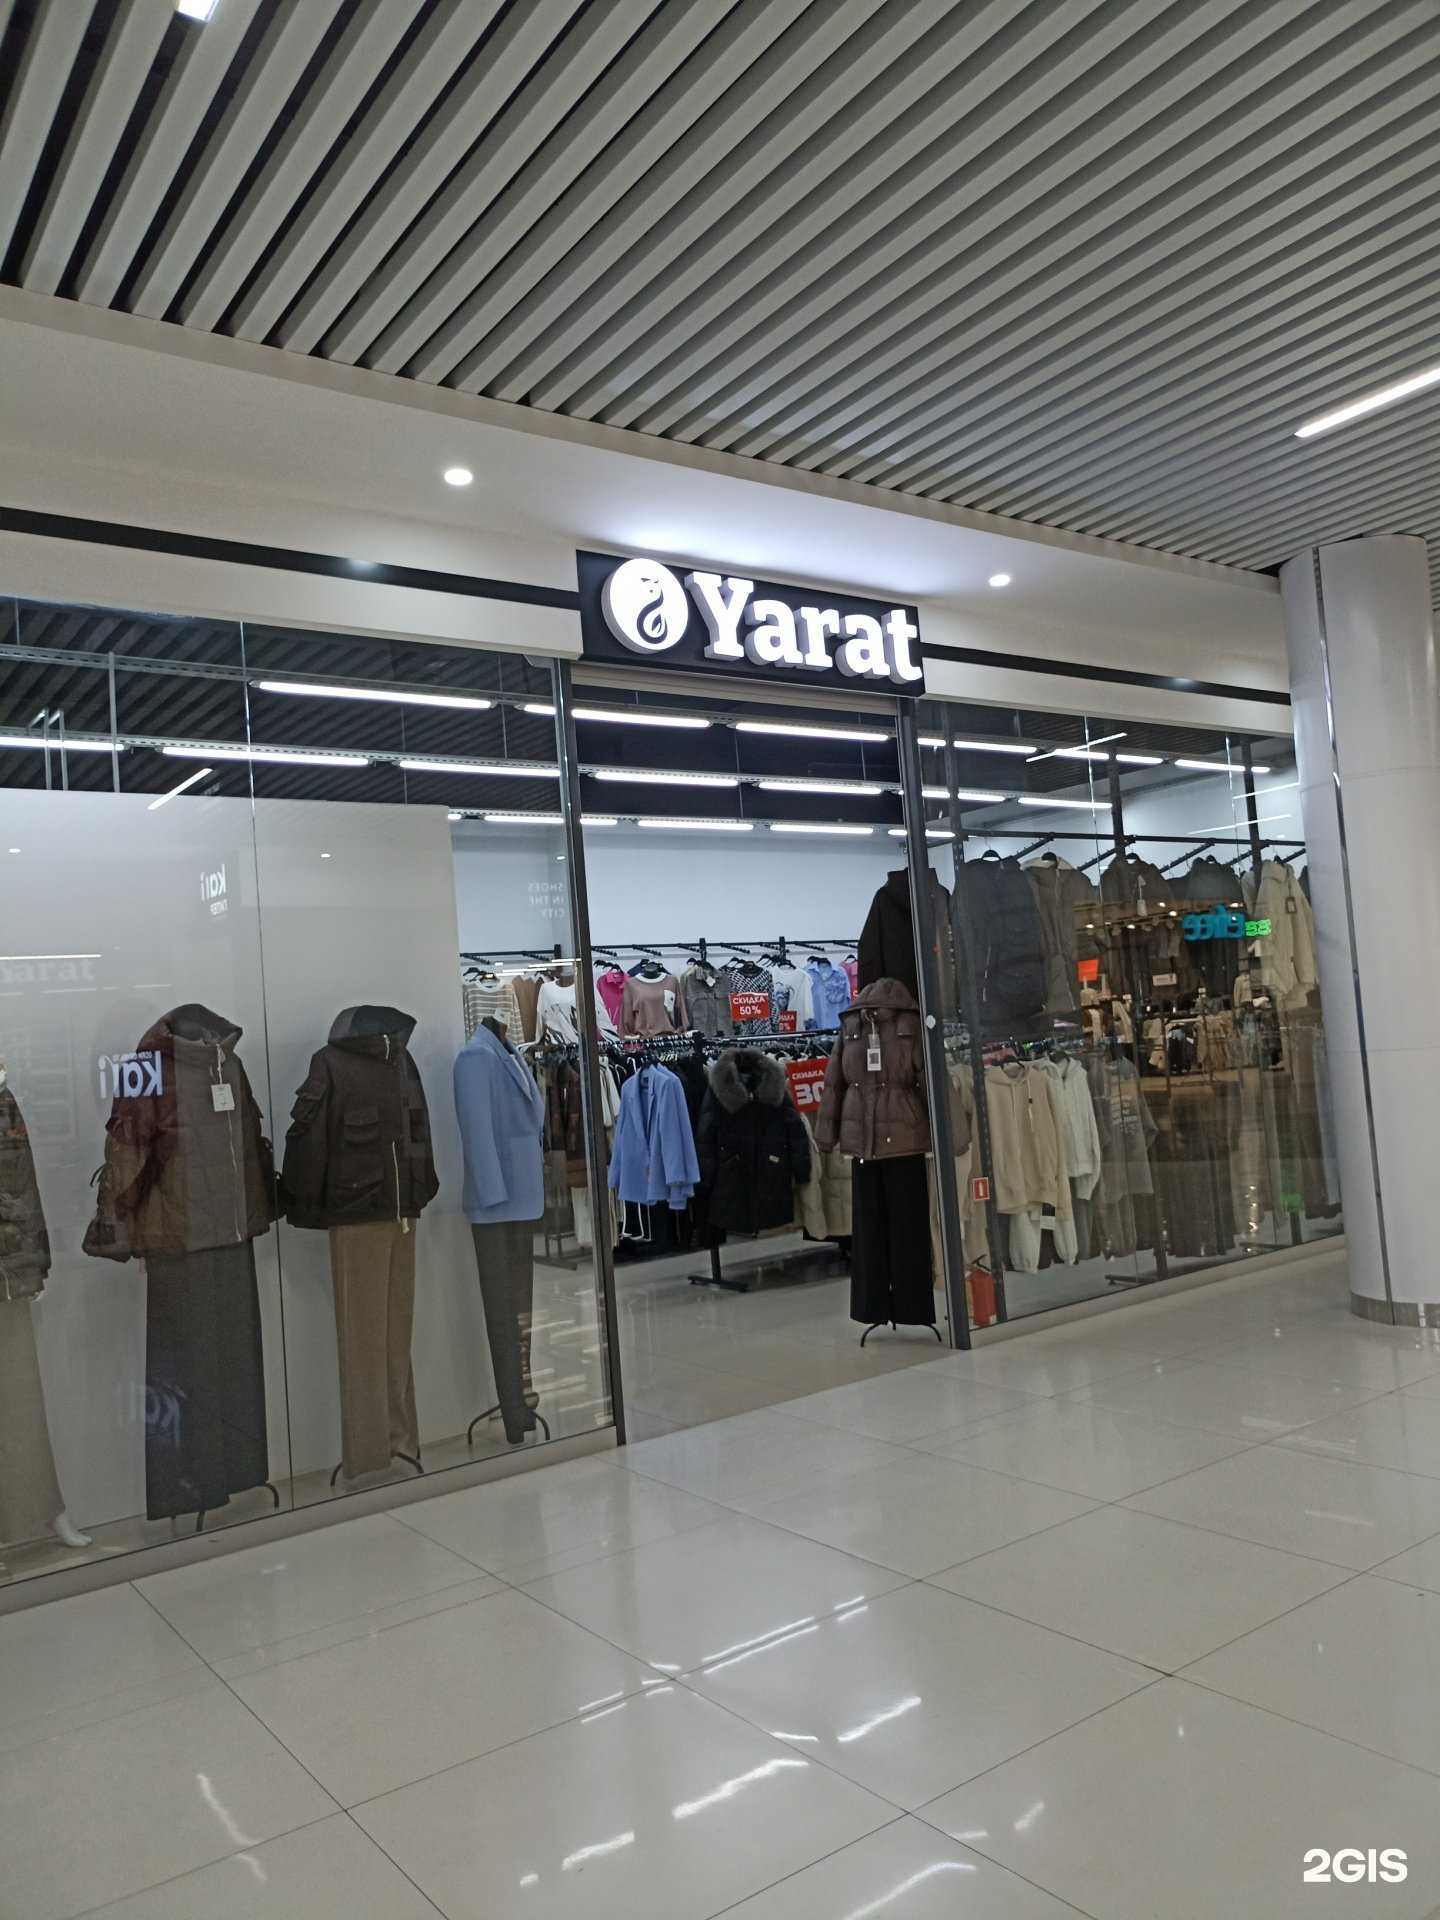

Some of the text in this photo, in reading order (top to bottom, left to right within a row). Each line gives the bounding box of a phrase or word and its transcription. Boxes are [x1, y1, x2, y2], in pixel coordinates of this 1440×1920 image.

[685, 570, 922, 684] Yarat
[732, 996, 766, 1005] СКИДКА
[739, 1005, 761, 1016] 50%
[792, 1069, 824, 1080] СКИДКА
